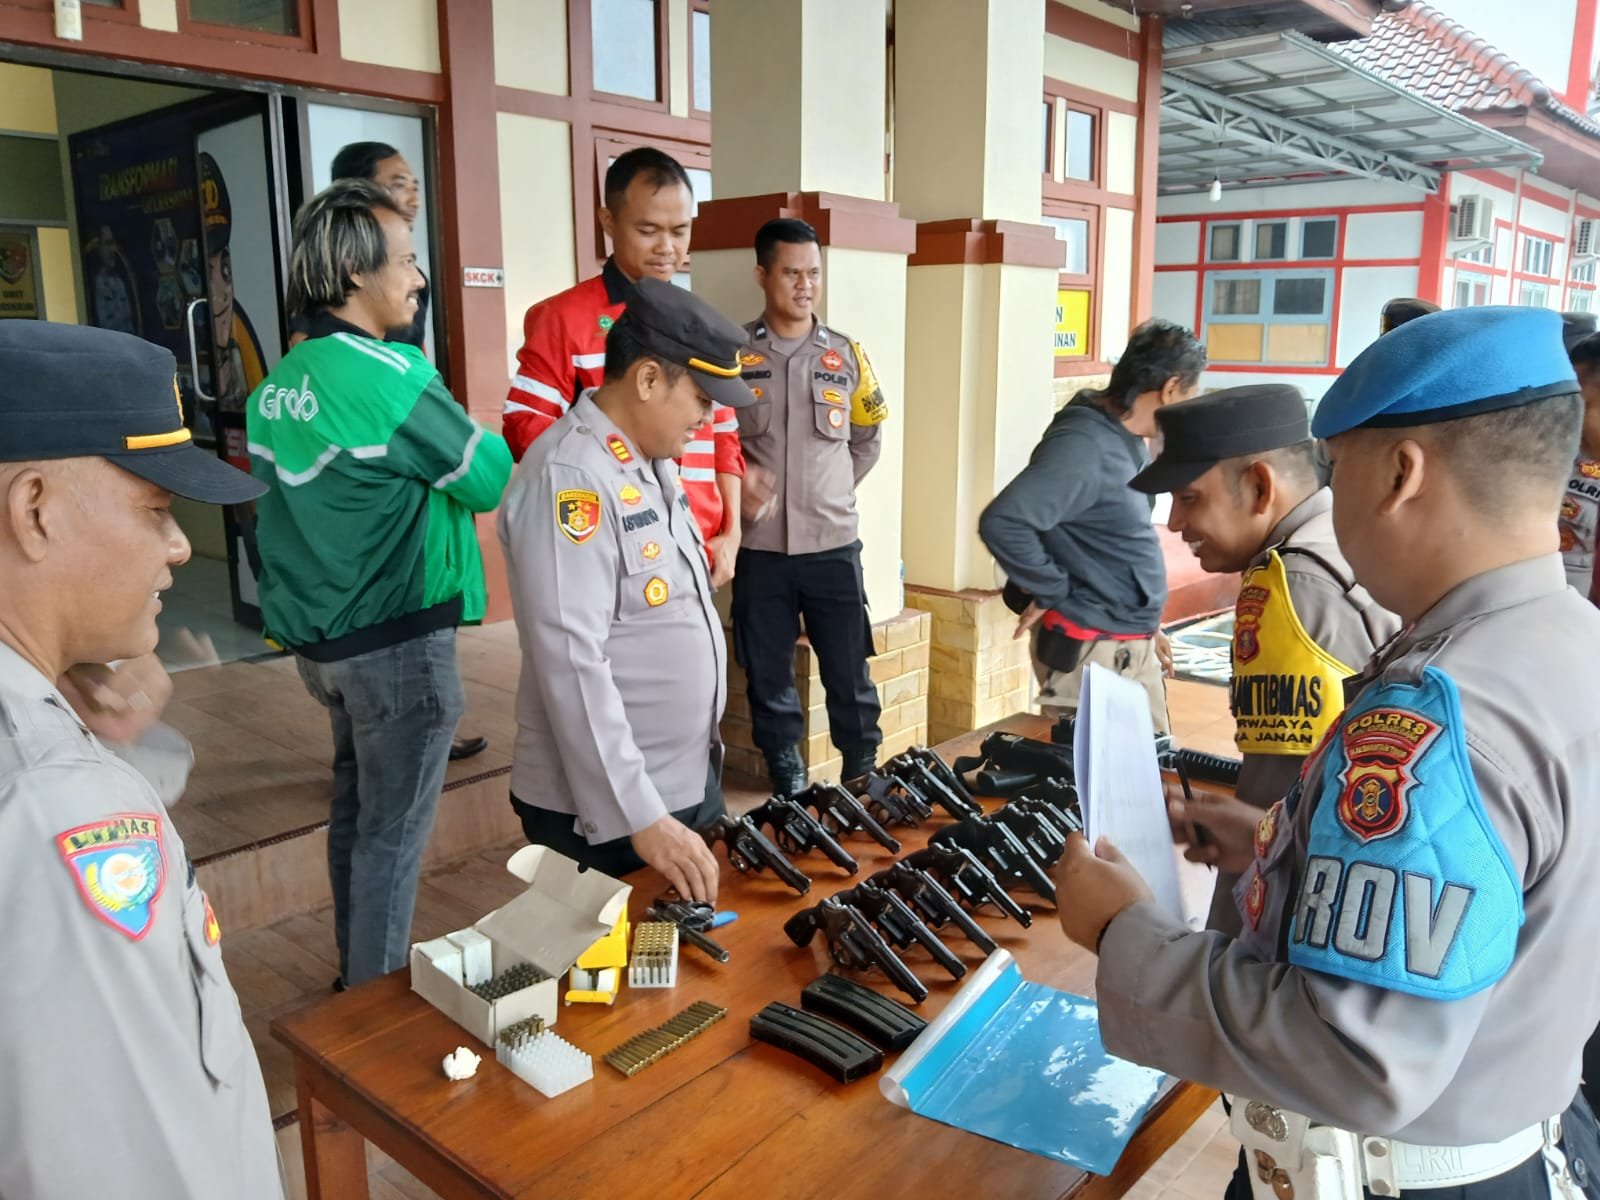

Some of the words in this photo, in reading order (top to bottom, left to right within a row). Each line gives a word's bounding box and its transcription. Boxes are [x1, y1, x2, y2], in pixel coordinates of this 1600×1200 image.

[464, 271, 495, 283] SKCK
[1053, 332, 1076, 347] INAN
[814, 371, 848, 387] POLRI
[258, 374, 319, 422] Grab
[1567, 479, 1600, 499] OLRI
[1236, 718, 1313, 730] RWAJAYA
[1347, 713, 1427, 736] POLRES
[1255, 732, 1313, 745] JANAN
